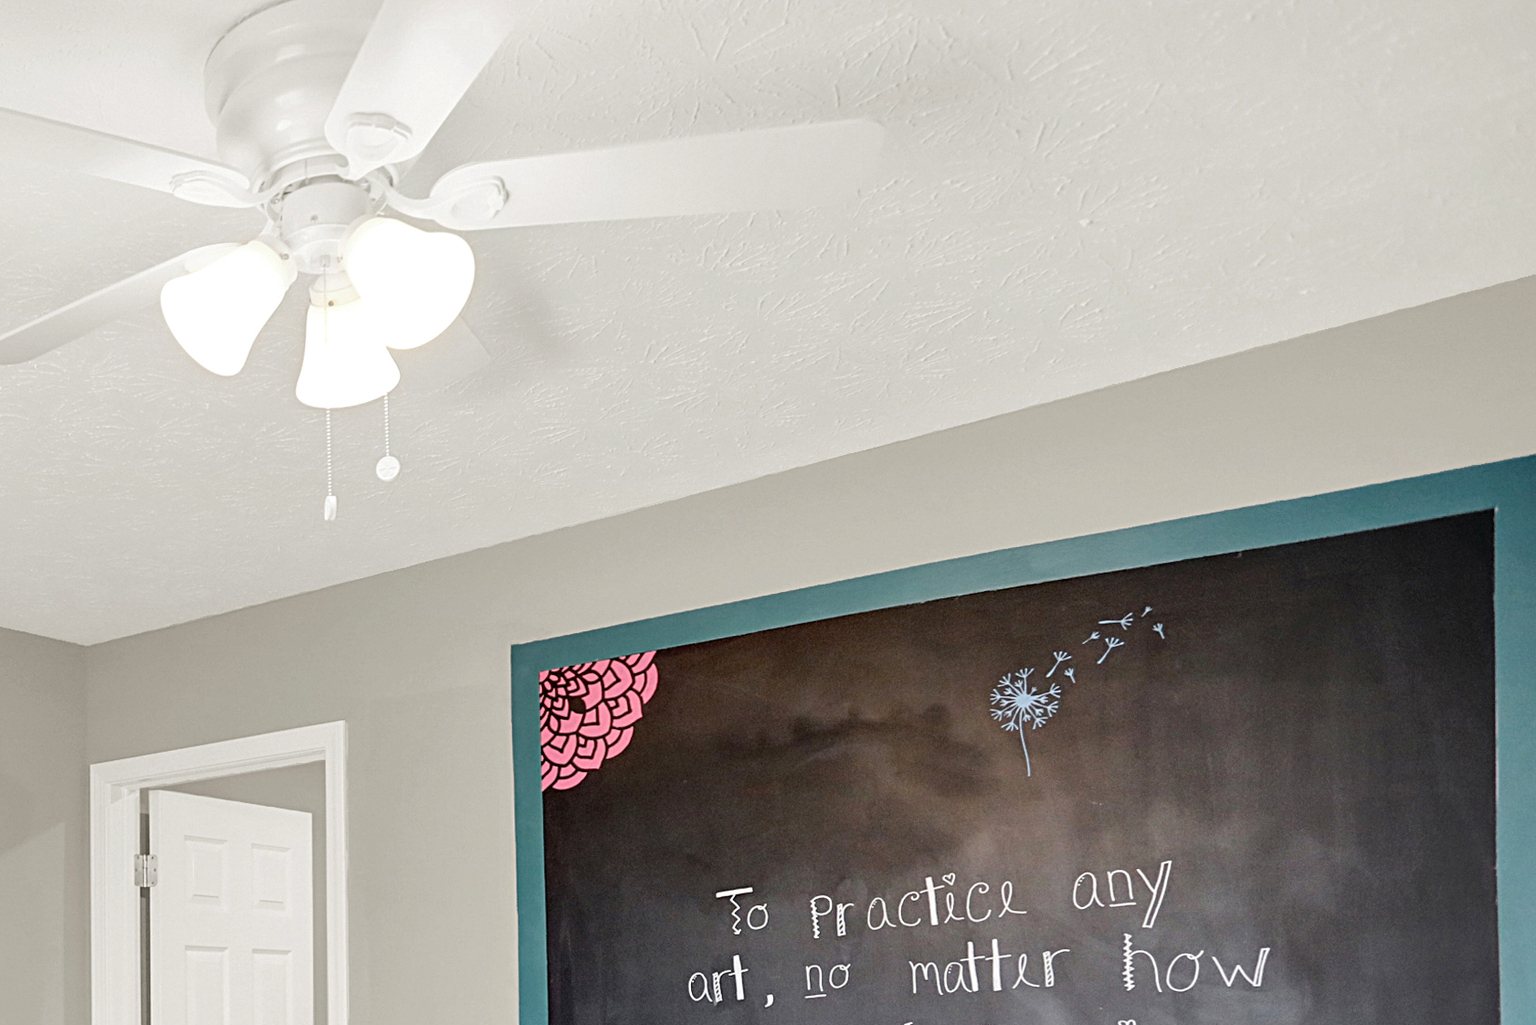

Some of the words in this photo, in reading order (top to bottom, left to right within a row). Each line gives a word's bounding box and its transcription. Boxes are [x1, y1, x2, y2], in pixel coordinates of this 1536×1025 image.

[715, 886, 769, 935] To
[1072, 860, 1173, 929] any
[687, 954, 774, 1008] art,
[804, 963, 852, 999] no
[908, 938, 1071, 996] matter
[1121, 932, 1271, 993] how
